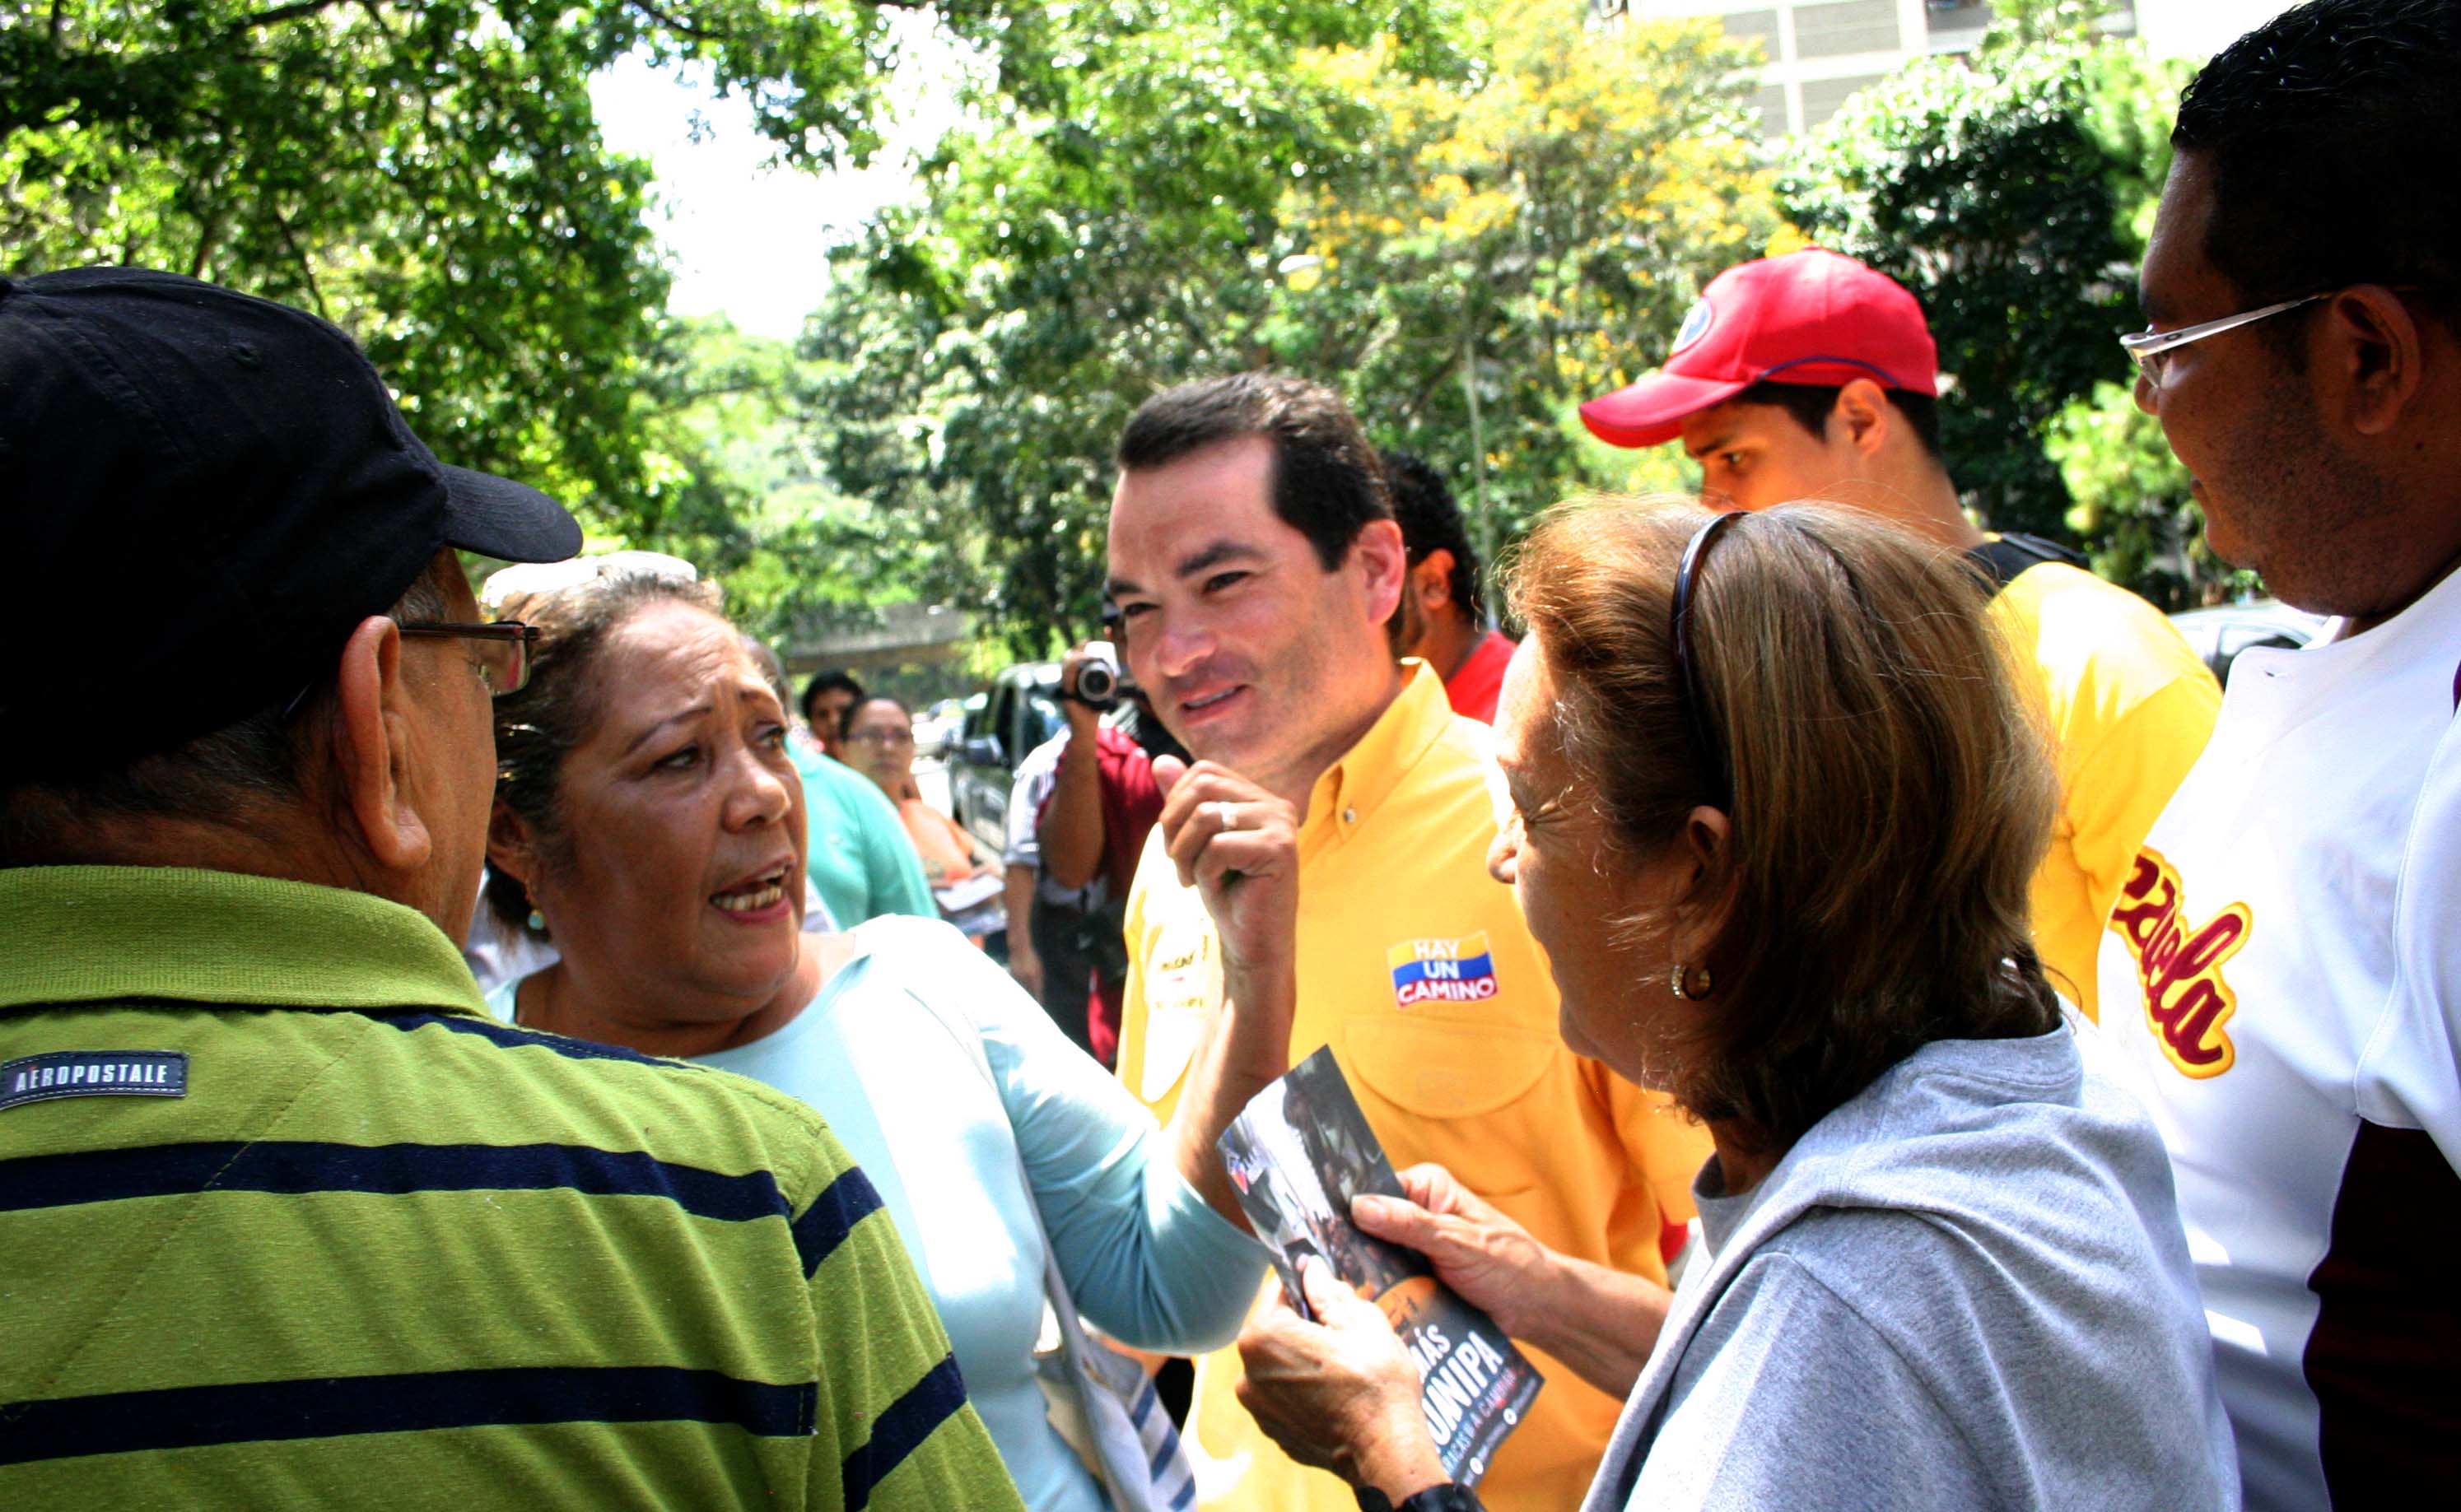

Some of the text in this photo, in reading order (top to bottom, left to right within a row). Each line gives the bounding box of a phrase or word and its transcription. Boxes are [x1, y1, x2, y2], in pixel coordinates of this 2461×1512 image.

[1413, 940, 1460, 961] HAY
[1423, 961, 1461, 979] UN
[1398, 976, 1495, 1003] CAMINO
[1421, 1330, 1504, 1454] UANIPA
[1441, 1431, 1471, 1478] RACAS
